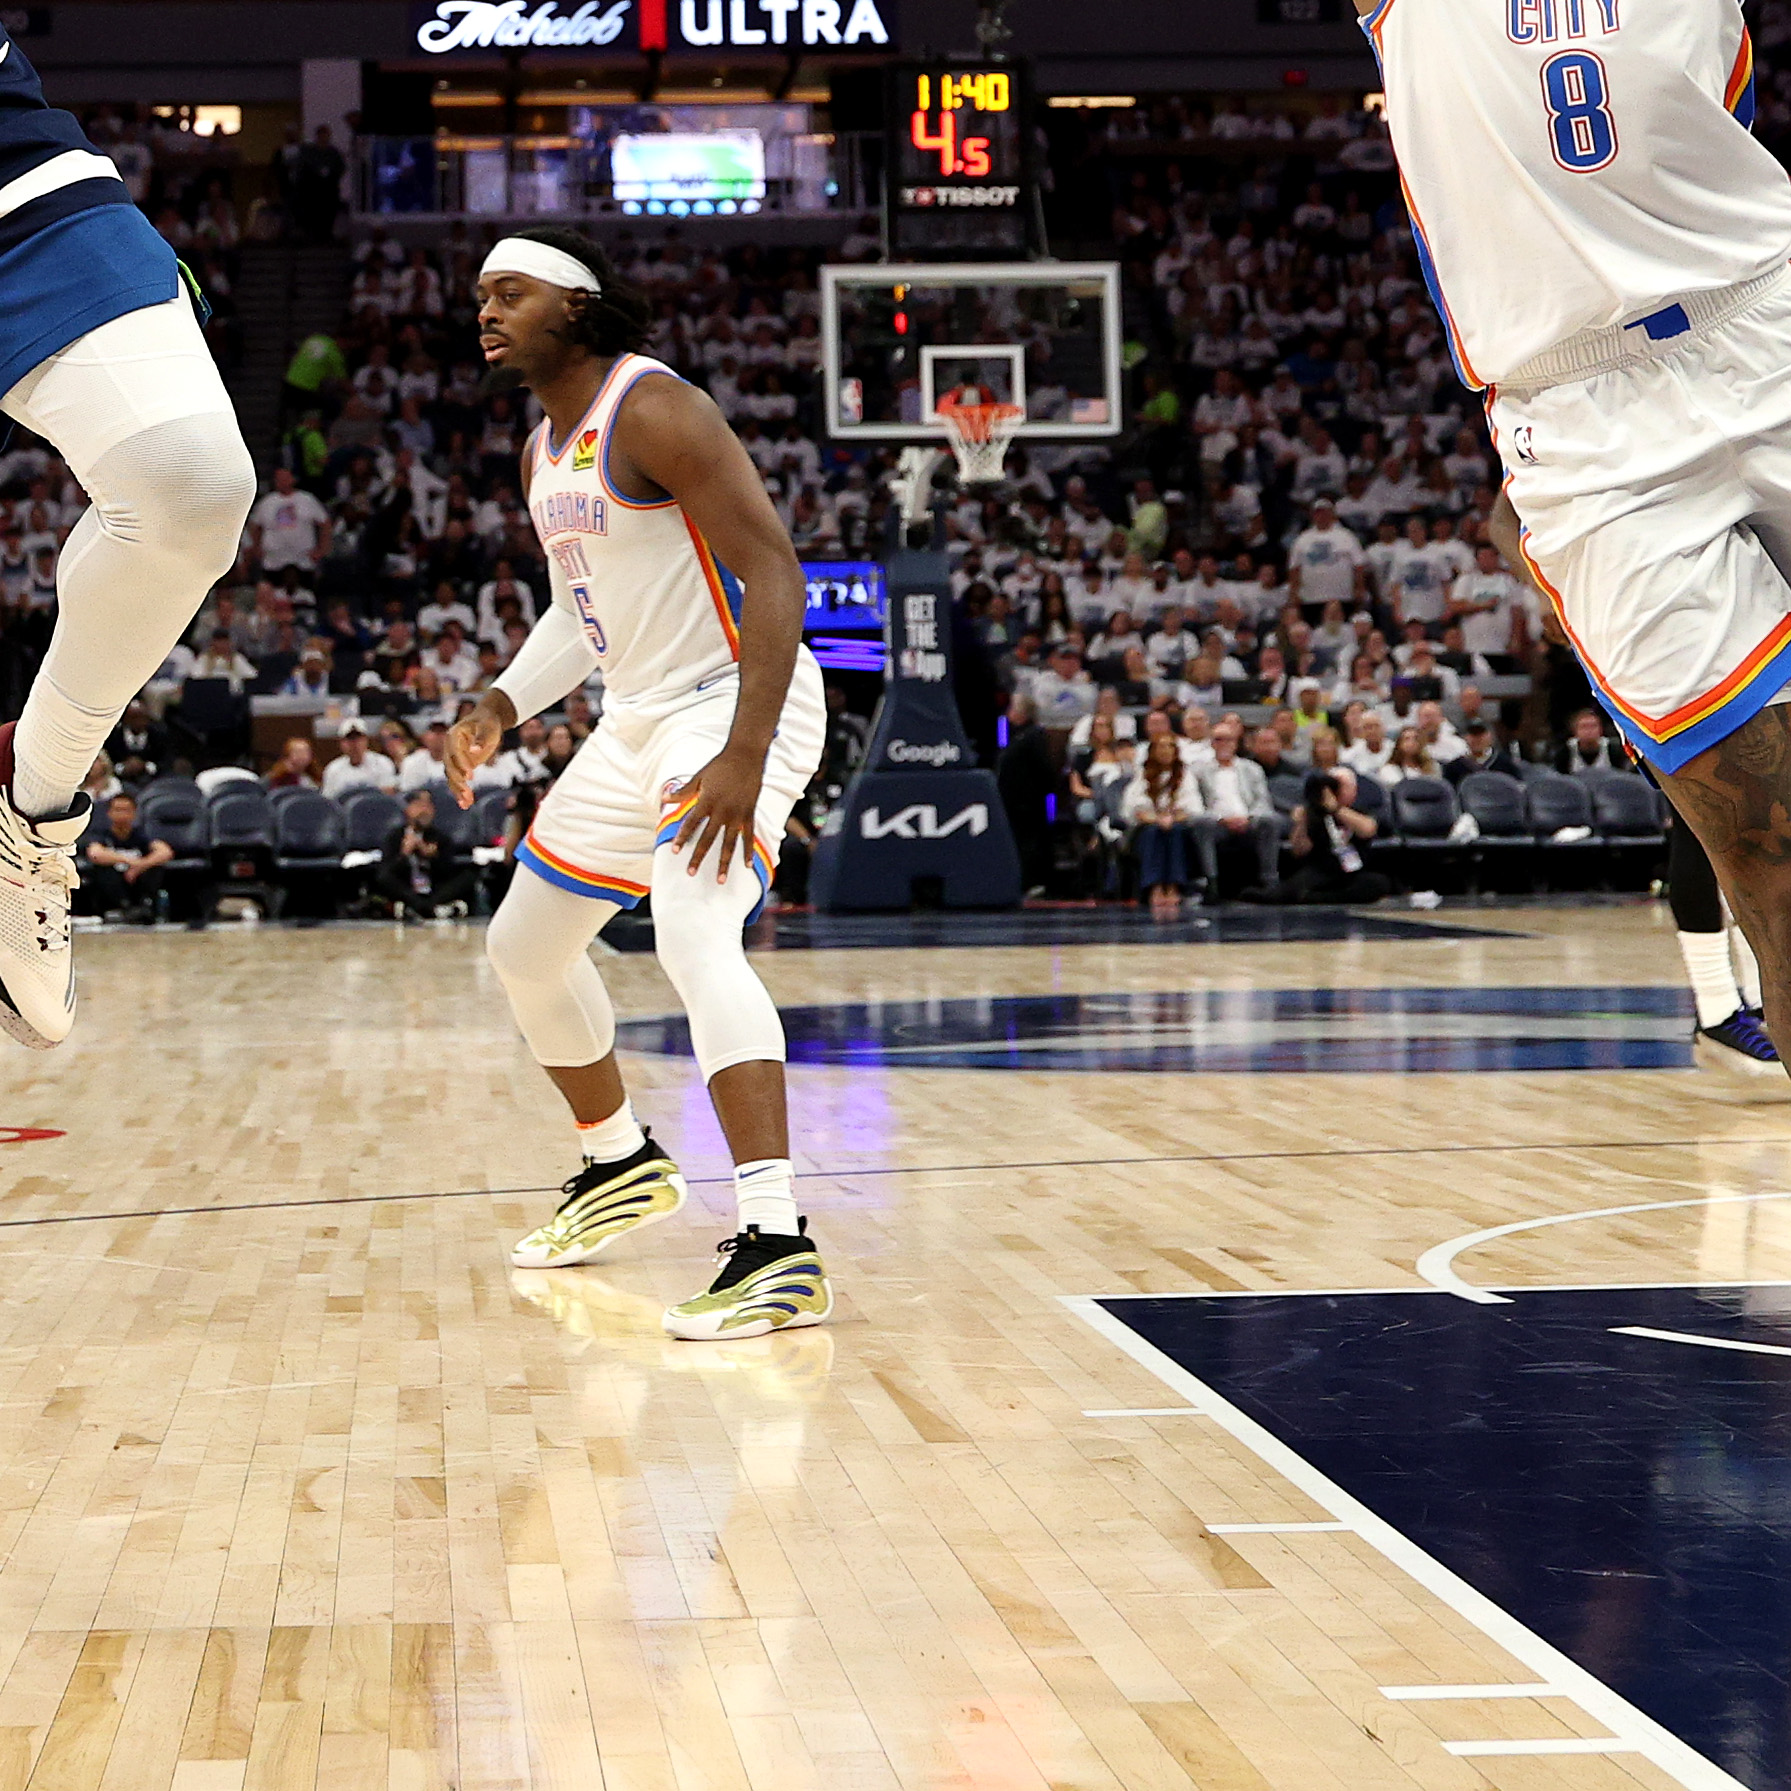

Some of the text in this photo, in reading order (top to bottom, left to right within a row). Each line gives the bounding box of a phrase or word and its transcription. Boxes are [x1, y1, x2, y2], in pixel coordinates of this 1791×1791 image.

[417, 0, 632, 53] Michelob
[917, 73, 1010, 112] 11:40
[1539, 49, 1618, 175] 8
[910, 110, 991, 176] 4.5
[936, 184, 1020, 206] TISSOT
[567, 582, 608, 658] 5
[887, 739, 962, 767] Google
